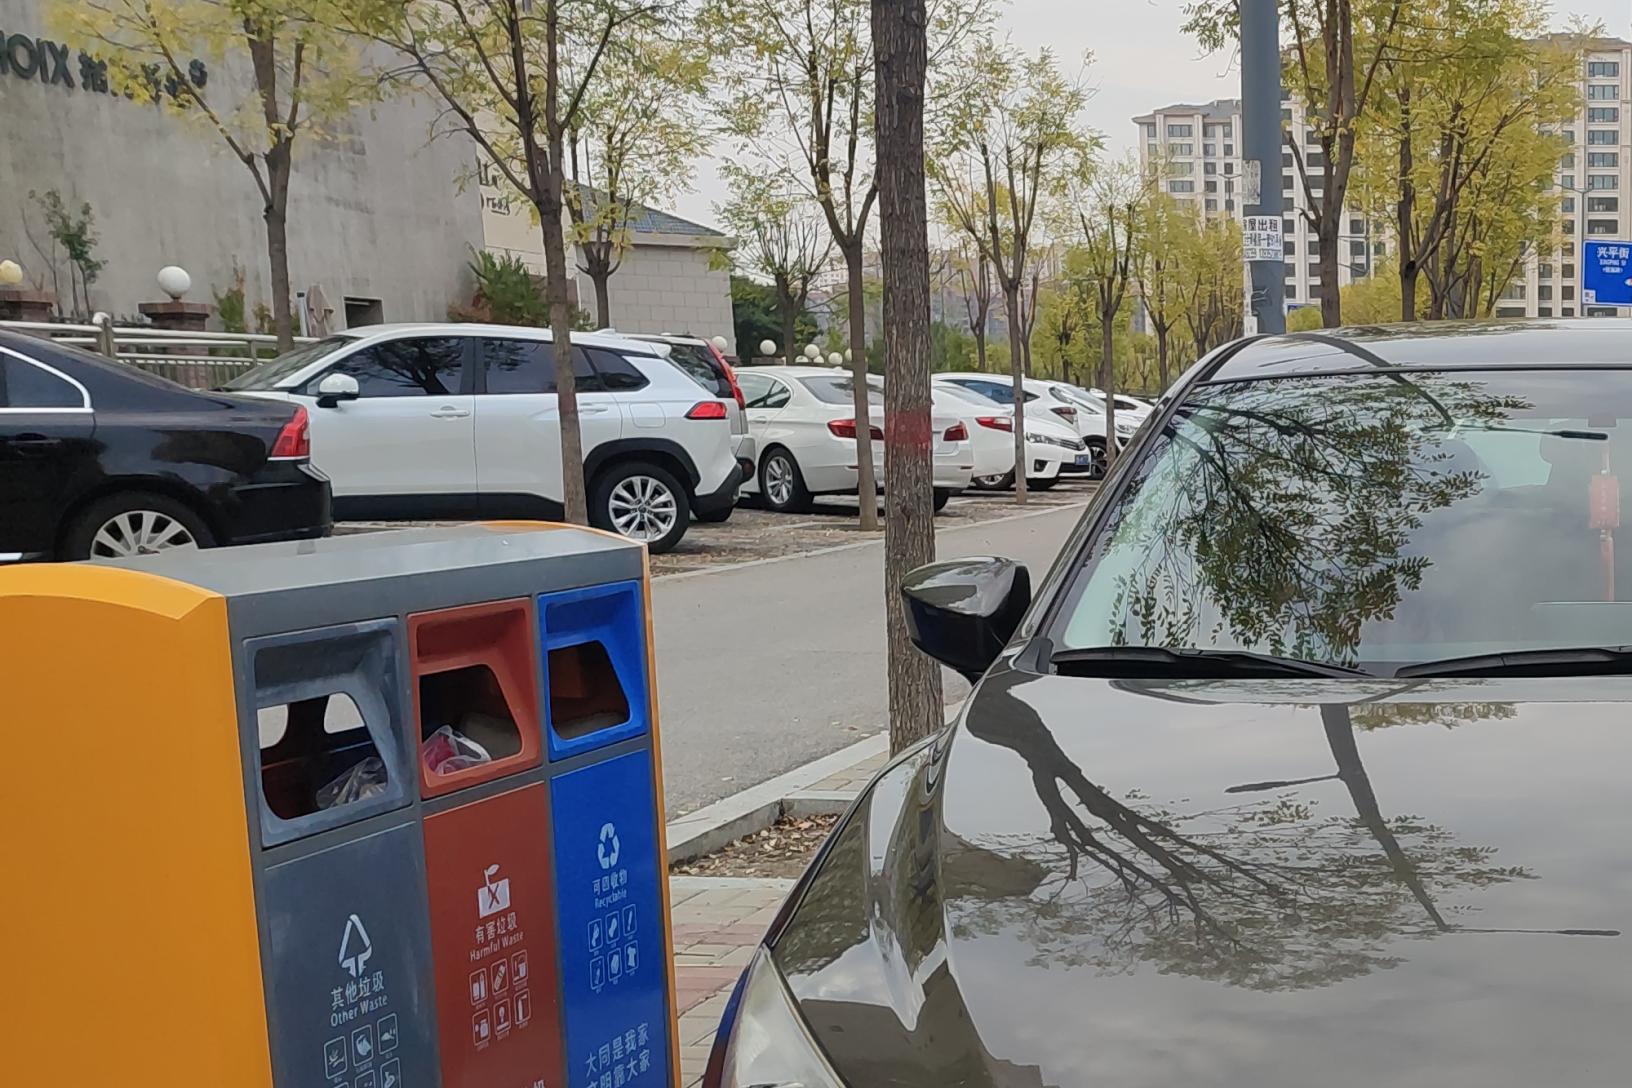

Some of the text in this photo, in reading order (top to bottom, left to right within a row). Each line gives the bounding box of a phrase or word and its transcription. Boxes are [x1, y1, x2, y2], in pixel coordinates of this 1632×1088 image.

[1597, 246, 1630, 260] 兴平街
[592, 868, 628, 896] 可回收物
[594, 887, 627, 910] Recyclable
[475, 911, 518, 945] 有害垃圾
[470, 931, 524, 962] Harmful Waste
[331, 970, 385, 1011] 其他垃圾
[330, 994, 388, 1027] Other Waste
[585, 1022, 649, 1078] 大同是我家
